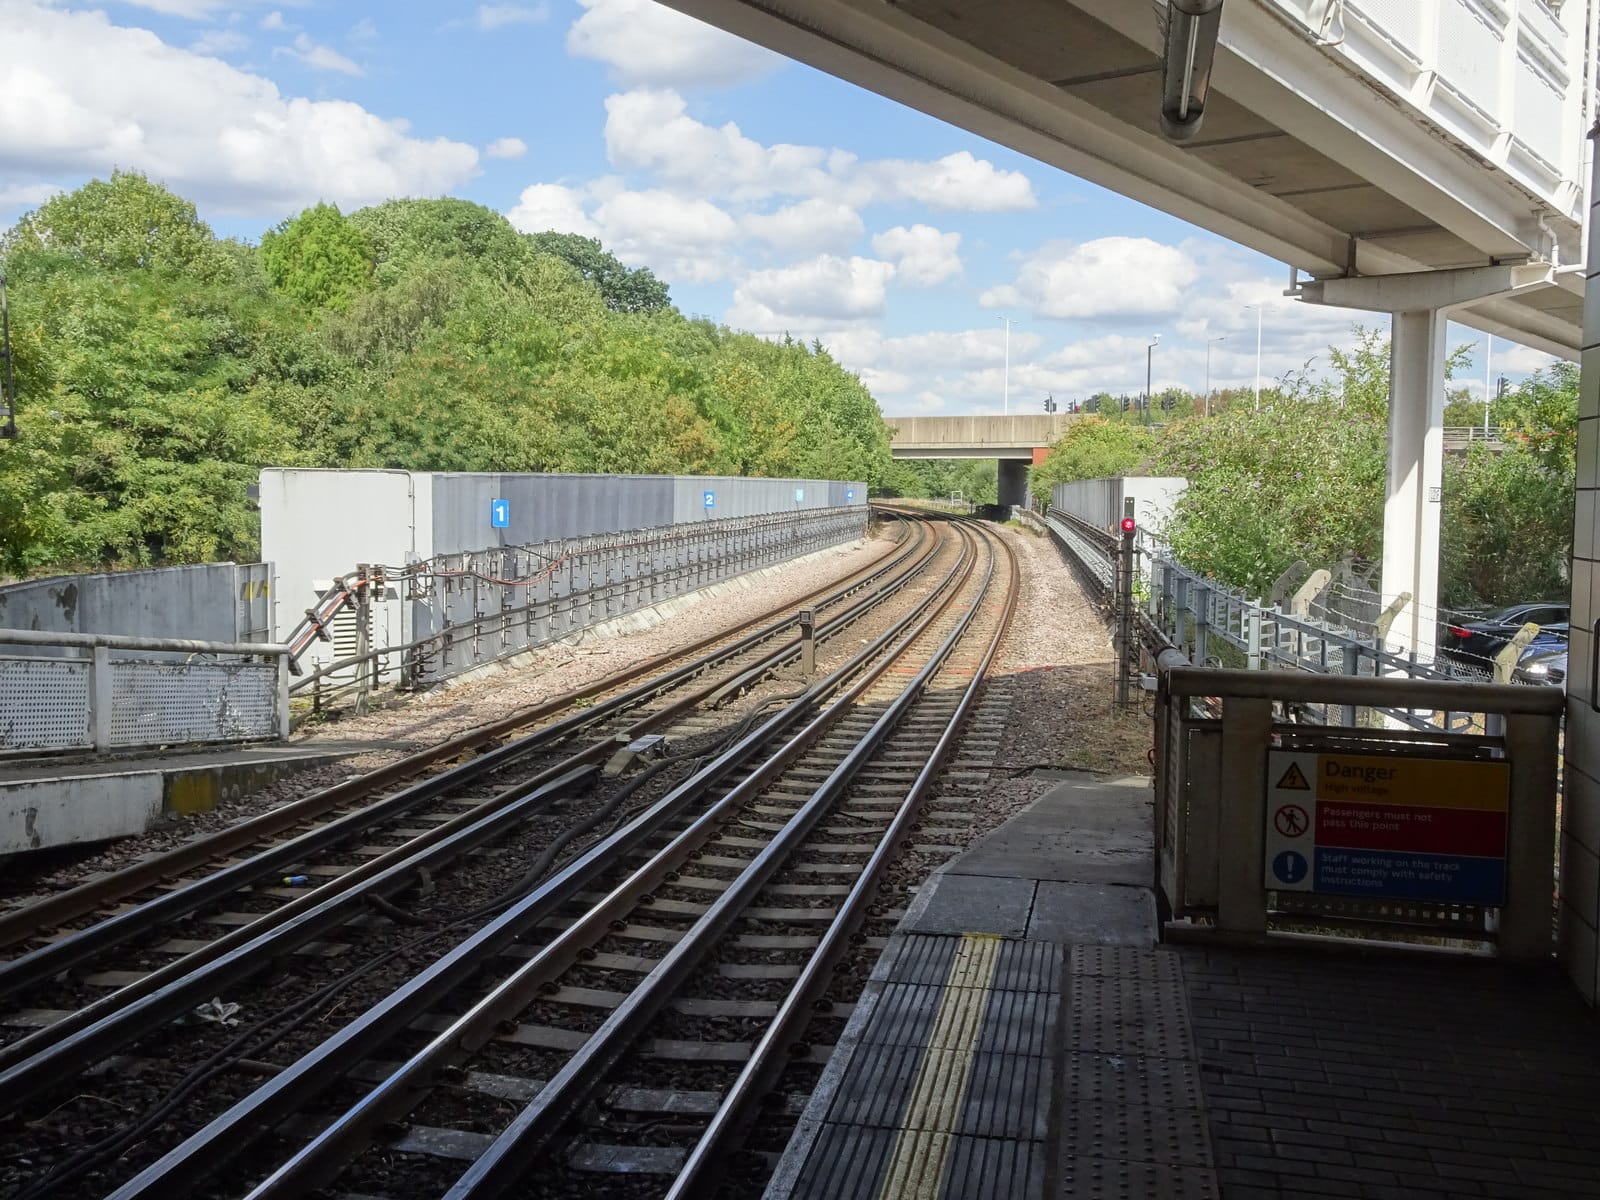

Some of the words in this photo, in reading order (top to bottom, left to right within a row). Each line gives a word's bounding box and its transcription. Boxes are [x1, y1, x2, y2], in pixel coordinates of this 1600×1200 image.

[705, 495, 713, 505] 2
[495, 505, 505, 521] 1
[1325, 760, 1397, 783] Danger
[1325, 783, 1349, 794] High
[1352, 785, 1390, 797] voltage
[1323, 806, 1381, 820] Passengers
[1384, 811, 1410, 821] must
[1414, 813, 1433, 822] not
[1323, 818, 1346, 829] pass
[1350, 818, 1369, 829] this
[1372, 820, 1400, 833] point
[1321, 853, 1347, 863] Staff
[1352, 854, 1392, 868] working
[1412, 859, 1430, 869] the
[1433, 861, 1461, 871] track
[1321, 865, 1348, 875] must
[1352, 866, 1387, 879] comply
[1392, 869, 1416, 879] with
[1418, 870, 1453, 883] safety
